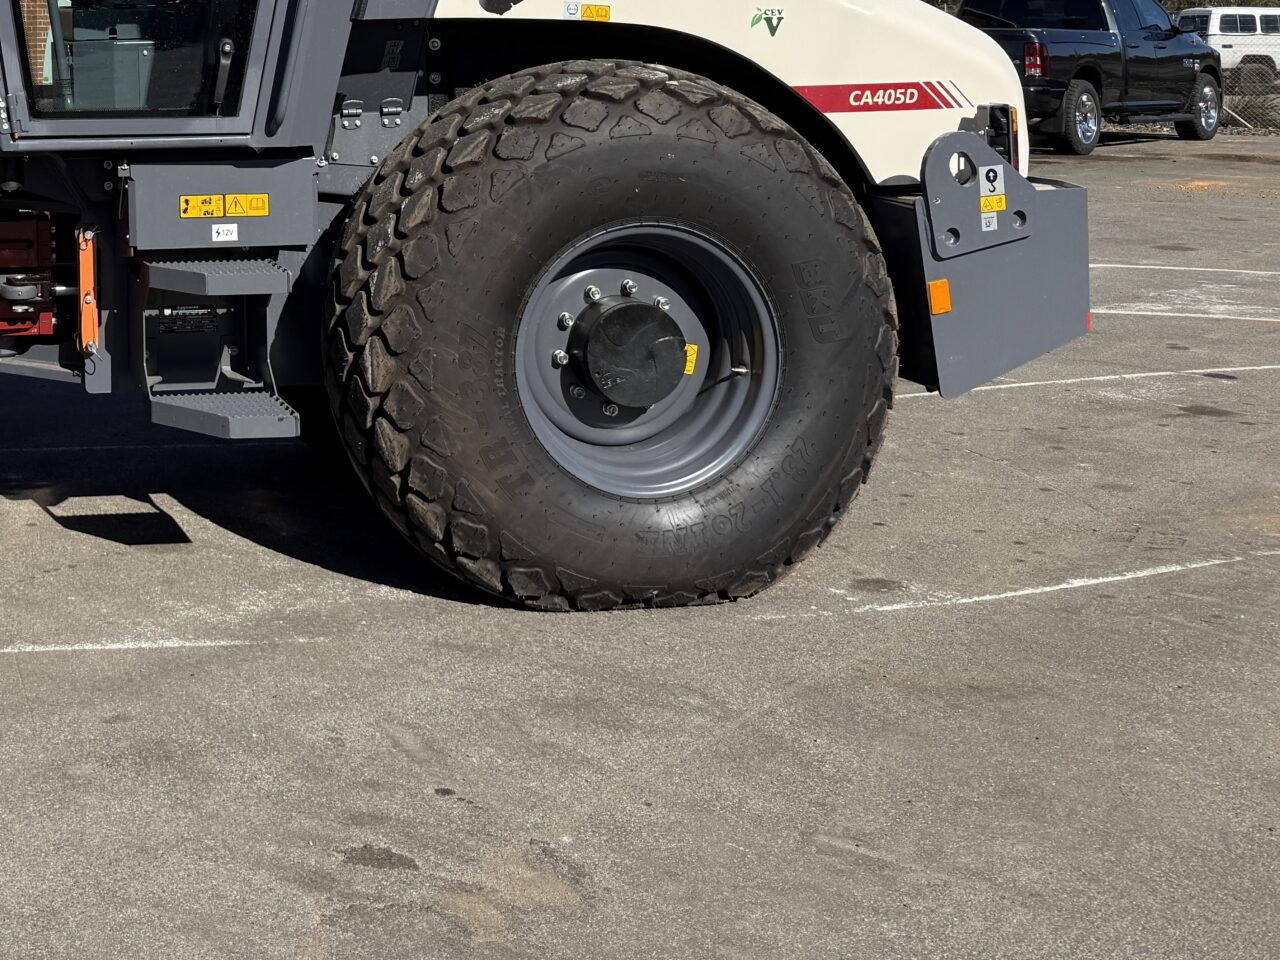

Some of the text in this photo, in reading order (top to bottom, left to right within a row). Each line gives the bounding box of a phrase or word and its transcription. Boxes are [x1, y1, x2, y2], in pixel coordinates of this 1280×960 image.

[763, 8, 784, 16] CEV
[849, 88, 919, 106] CA405D
[792, 257, 846, 343] BKT
